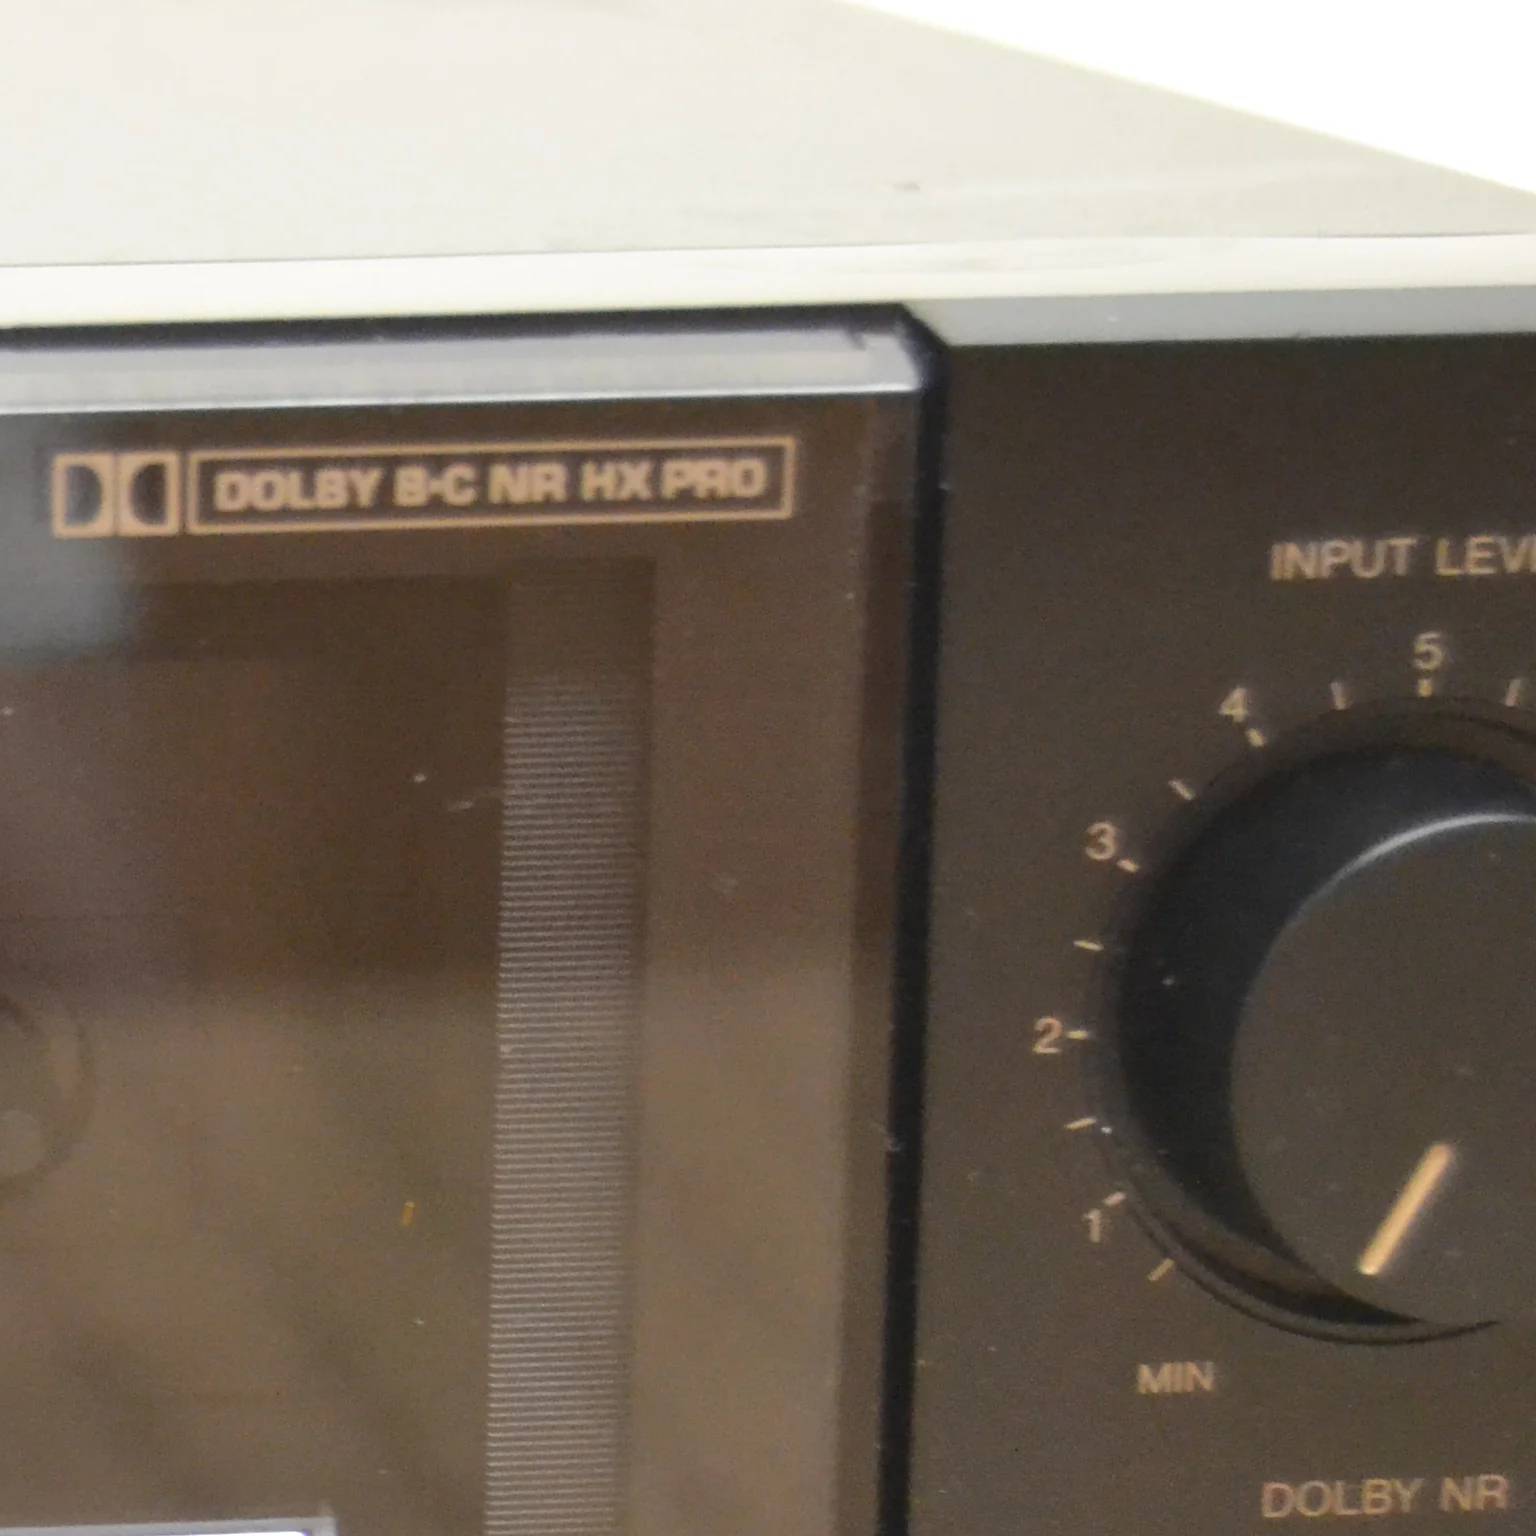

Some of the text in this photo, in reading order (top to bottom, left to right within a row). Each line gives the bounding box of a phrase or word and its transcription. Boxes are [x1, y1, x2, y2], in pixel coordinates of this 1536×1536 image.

[212, 464, 381, 514] DOLBY
[487, 460, 566, 505] NR
[581, 457, 653, 501] HX
[661, 455, 767, 500] PRO
[1270, 534, 1536, 580] INPUT LEV
[1413, 632, 1446, 672] 5
[1219, 685, 1249, 722] 4
[1085, 821, 1118, 861] 3
[1032, 1016, 1063, 1055] 2
[1084, 1208, 1103, 1243] 1
[1137, 1361, 1216, 1395] MIN
[1261, 1474, 1511, 1519] DOLBY NR
